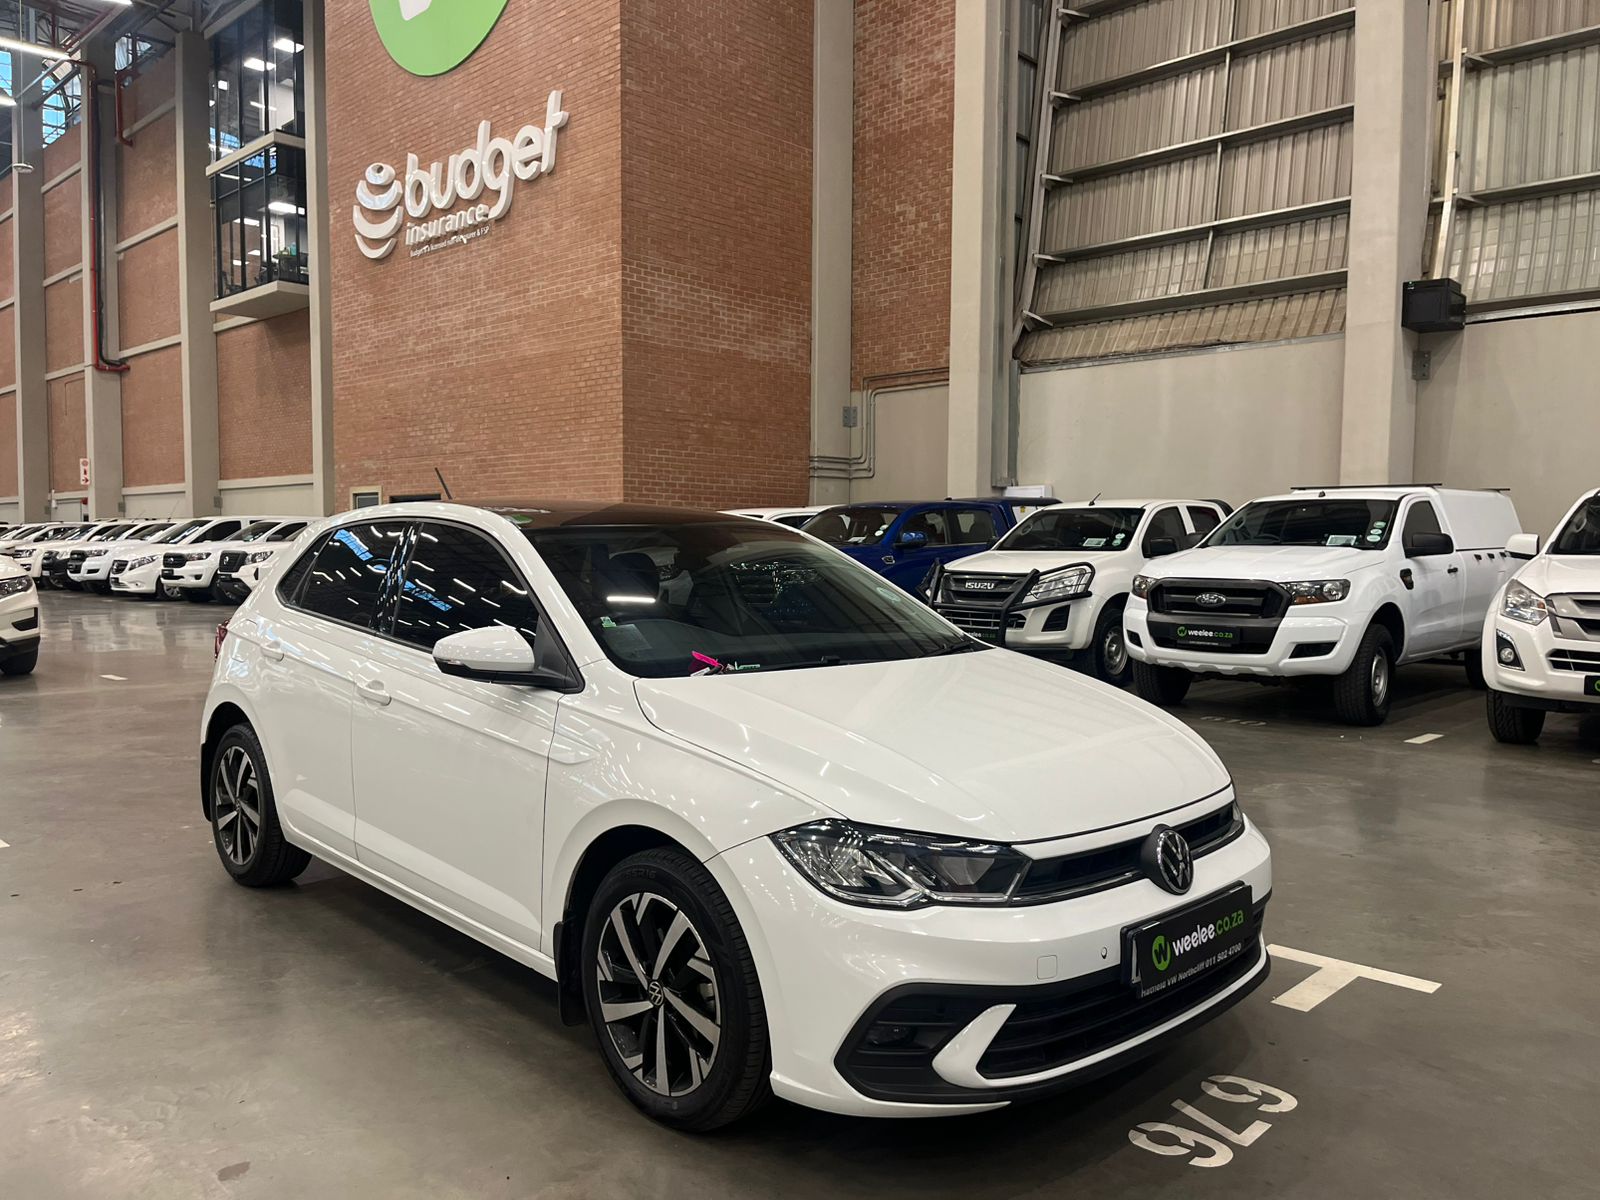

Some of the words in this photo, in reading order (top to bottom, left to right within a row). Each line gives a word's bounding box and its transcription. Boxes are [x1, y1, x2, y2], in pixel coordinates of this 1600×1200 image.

[405, 90, 570, 219] budget
[405, 204, 489, 246] insurance
[965, 581, 995, 590] ISUZU
[1188, 629, 1233, 639] weelee.co.za
[1172, 910, 1244, 957] weelee.co.za
[1205, 956, 1215, 968] 011
